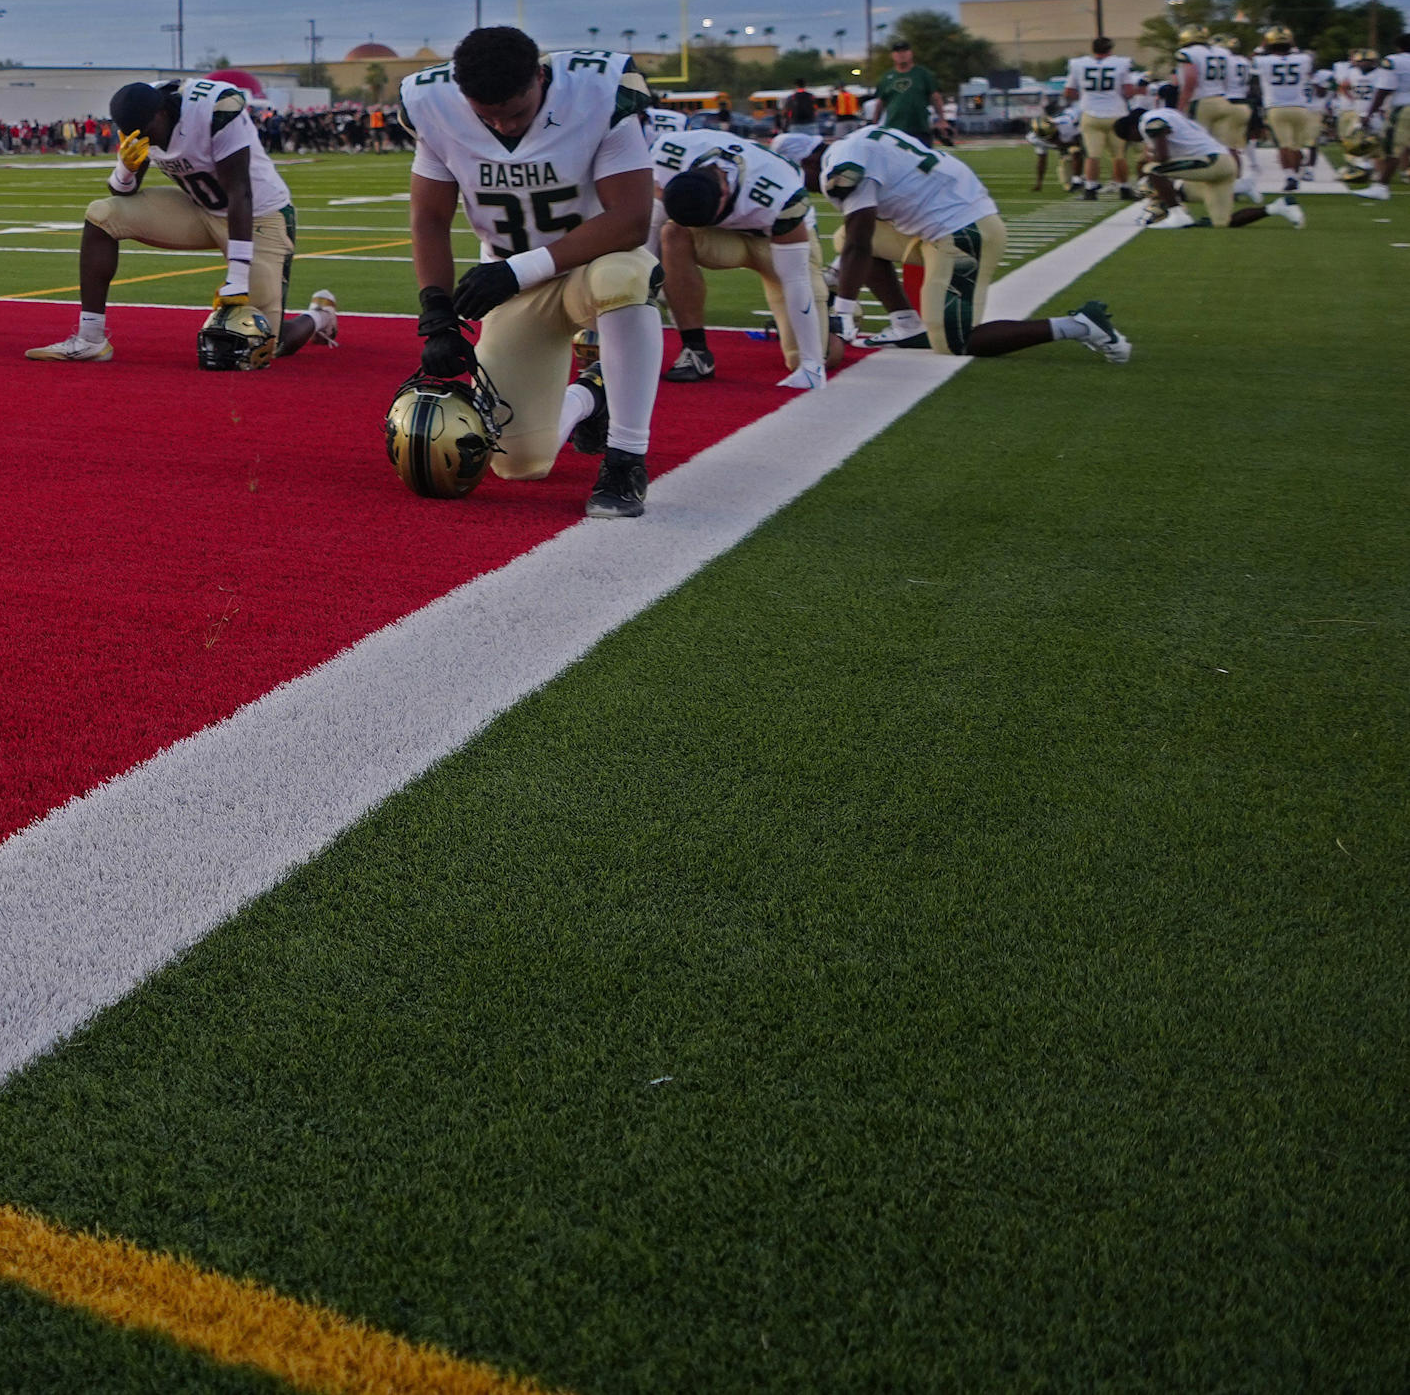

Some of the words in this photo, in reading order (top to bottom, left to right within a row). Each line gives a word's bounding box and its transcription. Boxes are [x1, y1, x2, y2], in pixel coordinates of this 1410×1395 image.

[1085, 67, 1116, 91] 56
[1271, 63, 1301, 85] 55
[188, 81, 215, 102] 40
[656, 141, 688, 170] 84
[479, 161, 559, 188] BASHA
[749, 175, 784, 208] 84
[475, 184, 584, 260] 35
